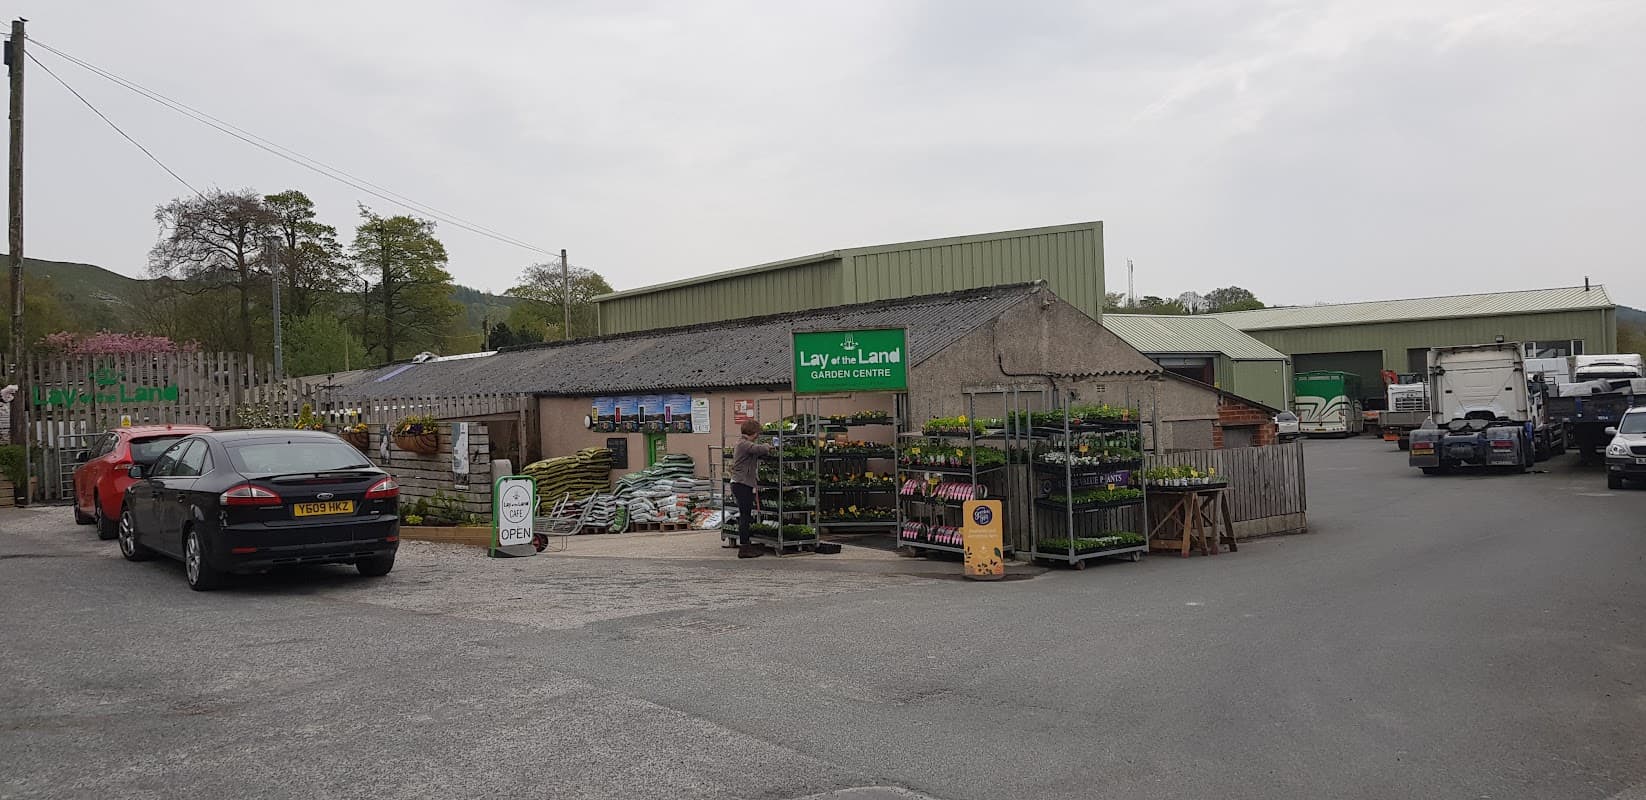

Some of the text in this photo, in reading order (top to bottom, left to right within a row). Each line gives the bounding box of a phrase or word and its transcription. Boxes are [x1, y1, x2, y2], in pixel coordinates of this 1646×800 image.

[800, 348, 900, 369] Lay of the Land
[811, 368, 891, 379] GARDEN CENTRE
[32, 385, 77, 409] Lay
[119, 383, 179, 403] Land
[328, 501, 349, 512] HKZ
[502, 528, 530, 540] OPEN
